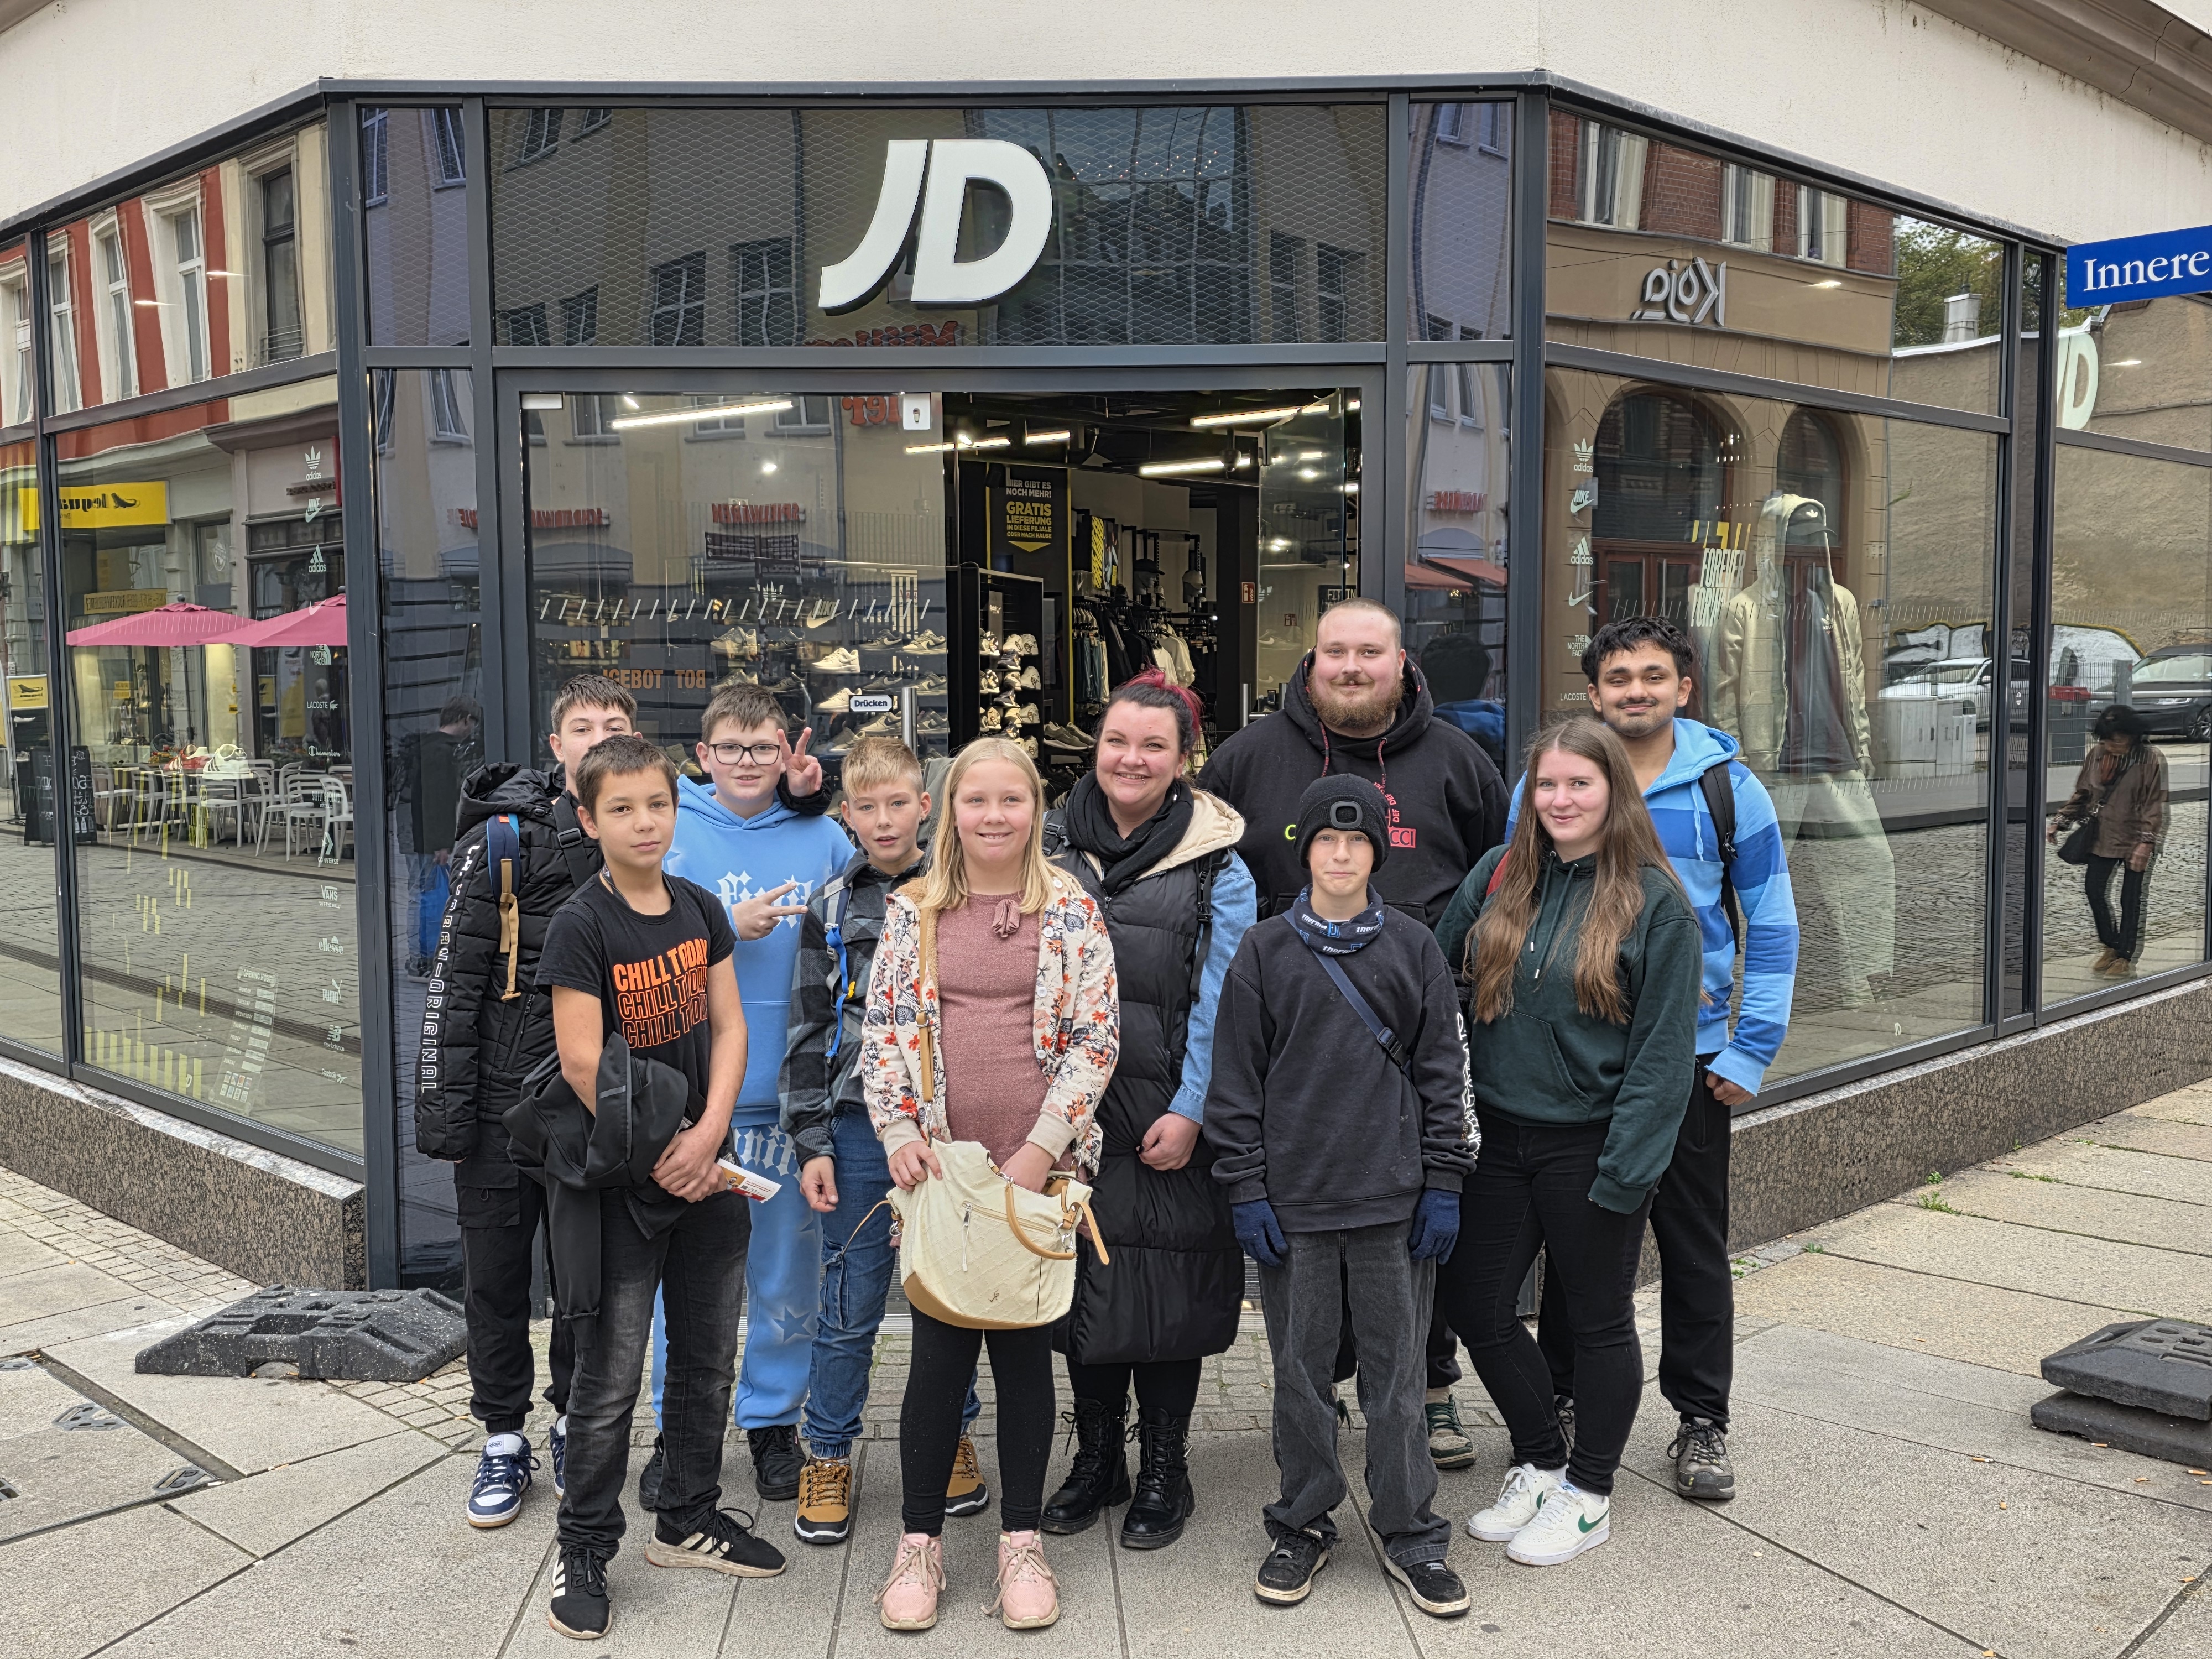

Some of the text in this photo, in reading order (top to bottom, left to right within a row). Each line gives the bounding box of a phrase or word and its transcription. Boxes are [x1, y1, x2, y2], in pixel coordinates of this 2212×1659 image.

[818, 138, 1055, 311] JD
[2083, 251, 2210, 292] Innere
[1574, 463, 1593, 472] adidas
[306, 471, 321, 481] adidas
[1006, 488, 1051, 498] NOCH MEHR!
[1574, 489, 1589, 503] NIKE
[308, 498, 320, 512] NIKE
[1006, 501, 1051, 516] GRATIS
[1006, 515, 1052, 525] LIEFERUNG
[309, 562, 326, 572] adidas
[1571, 554, 1593, 565] adidas
[1700, 548, 1746, 587] FOREVER
[308, 745, 341, 757] Champion
[321, 885, 338, 901] VANS
[319, 937, 343, 954] ellesse
[613, 938, 708, 992] CHILL TODAY
[322, 988, 338, 1004] PUMA
[618, 983, 677, 1020] CHILL
[622, 1011, 680, 1049] CHILL
